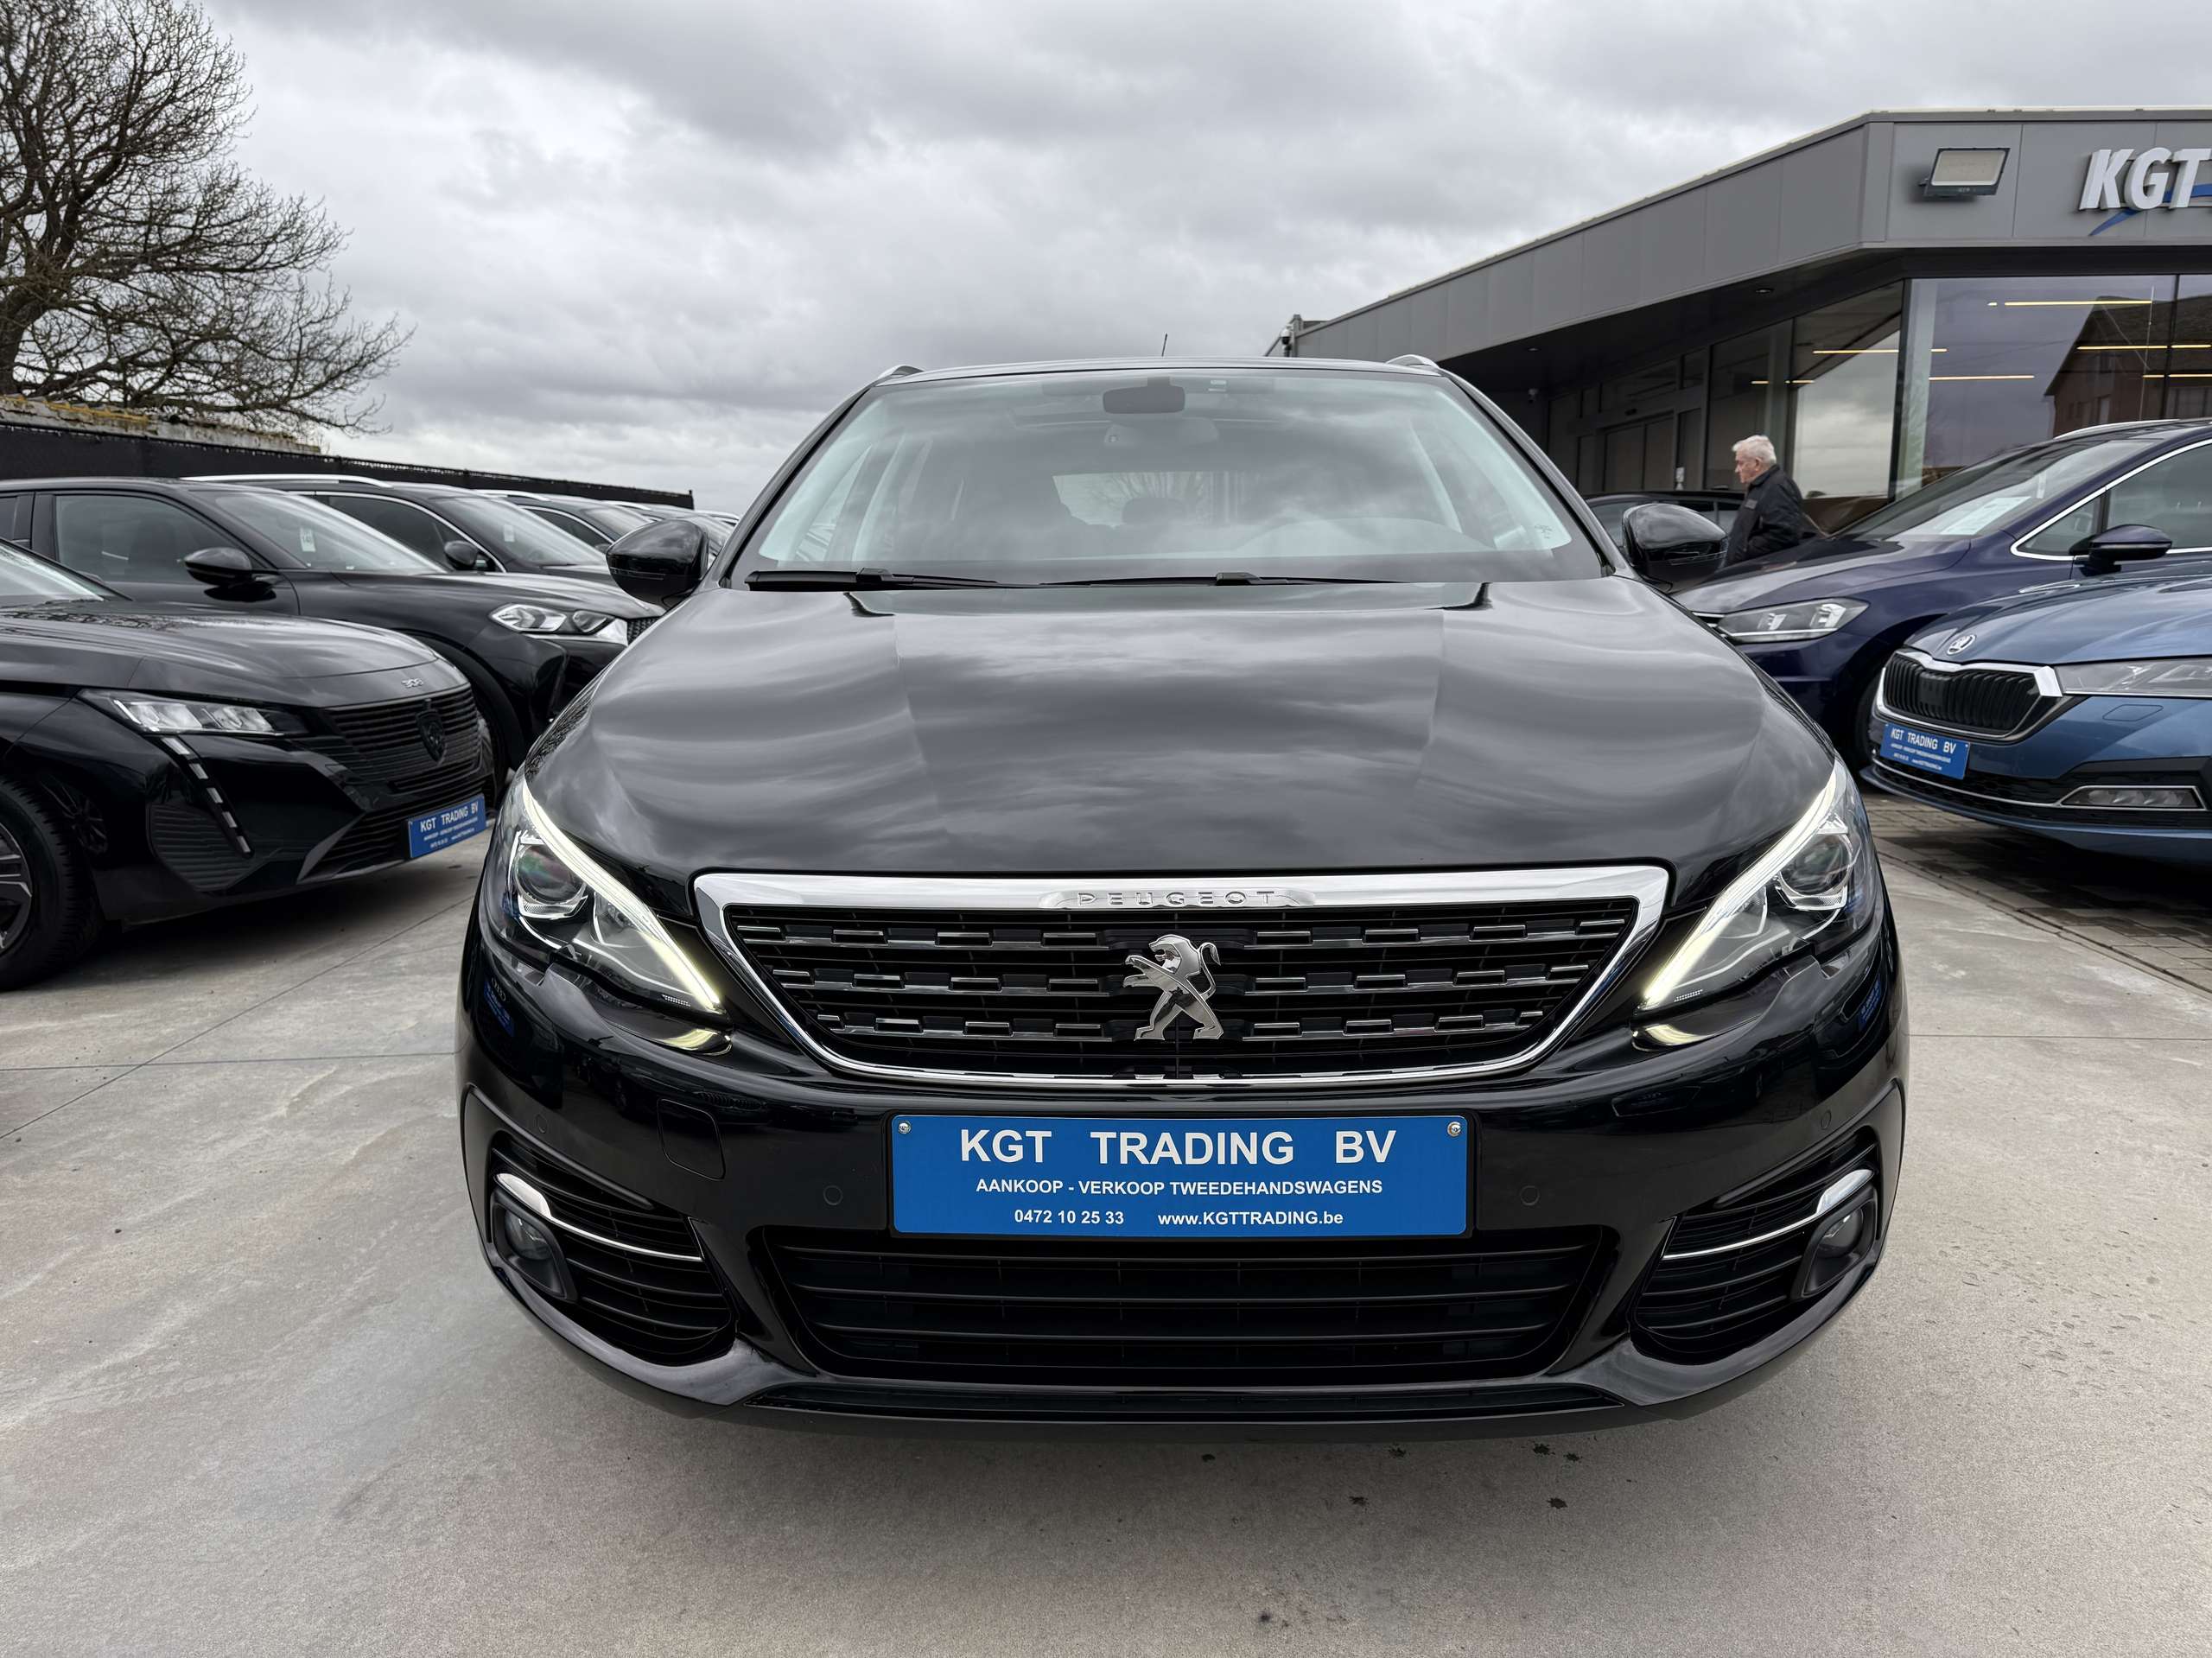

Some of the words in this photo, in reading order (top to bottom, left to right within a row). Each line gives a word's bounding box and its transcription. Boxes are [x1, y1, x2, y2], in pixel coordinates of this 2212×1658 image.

[2079, 148, 2212, 210] KGT
[1891, 727, 1904, 740] KGT
[1907, 732, 1938, 750] TRADING
[1942, 741, 1957, 754] BV
[420, 817, 436, 833] KGT
[441, 806, 468, 825] TRADING
[471, 801, 479, 814] BV
[1078, 891, 1274, 905] PEUGEOT
[961, 1128, 1052, 1163] KGT
[1090, 1131, 1294, 1165] TRADING
[1335, 1129, 1397, 1164] BV
[976, 1178, 1064, 1194] AANKOOP
[1077, 1180, 1165, 1196] VERKOOP
[1169, 1179, 1382, 1196] TWEEDEHANDSWAGENS
[1014, 1209, 1052, 1223] 0472
[1058, 1210, 1077, 1224] 10
[1081, 1210, 1101, 1224] 25
[1105, 1210, 1124, 1225] 33
[1157, 1210, 1344, 1225] www.KGTTRADING.be
